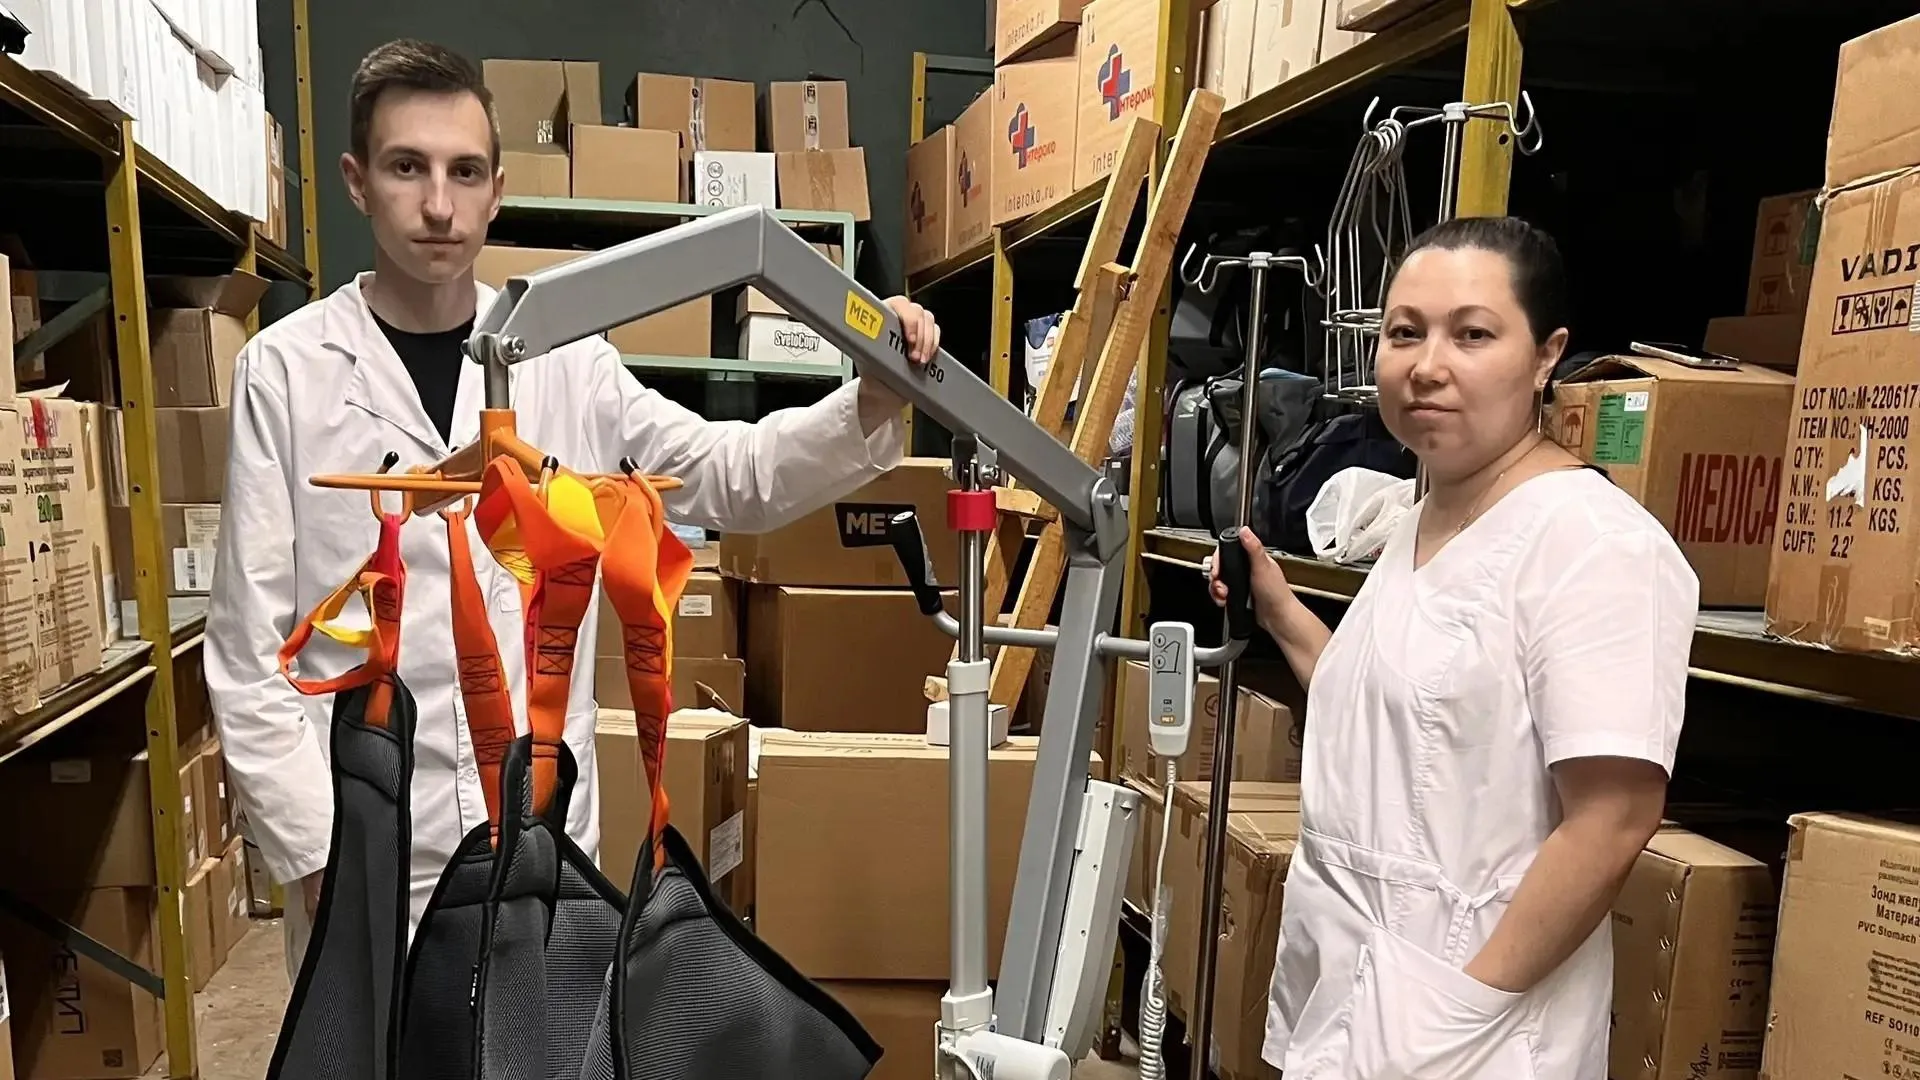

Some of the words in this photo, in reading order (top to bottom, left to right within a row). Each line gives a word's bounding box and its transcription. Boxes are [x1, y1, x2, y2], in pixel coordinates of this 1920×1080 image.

[774, 330, 821, 352] SvetoCopy
[1802, 387, 1827, 410] LOT
[1856, 384, 1920, 410] M-220617
[1797, 416, 1828, 439] ITEM
[1877, 445, 1908, 470] PCS.
[1789, 474, 1820, 498] N.W.:
[1872, 477, 1904, 502] KGS.
[846, 511, 897, 535] ME
[1786, 501, 1816, 526] G.W.:
[1829, 505, 1854, 529] 11.2
[1868, 507, 1900, 534] KGS.
[1783, 530, 1816, 554] CUFT:
[1871, 884, 1896, 904] Зонд
[1857, 920, 1877, 934] PVC
[1877, 925, 1917, 944] Stomach
[1865, 1010, 1884, 1025] REF
